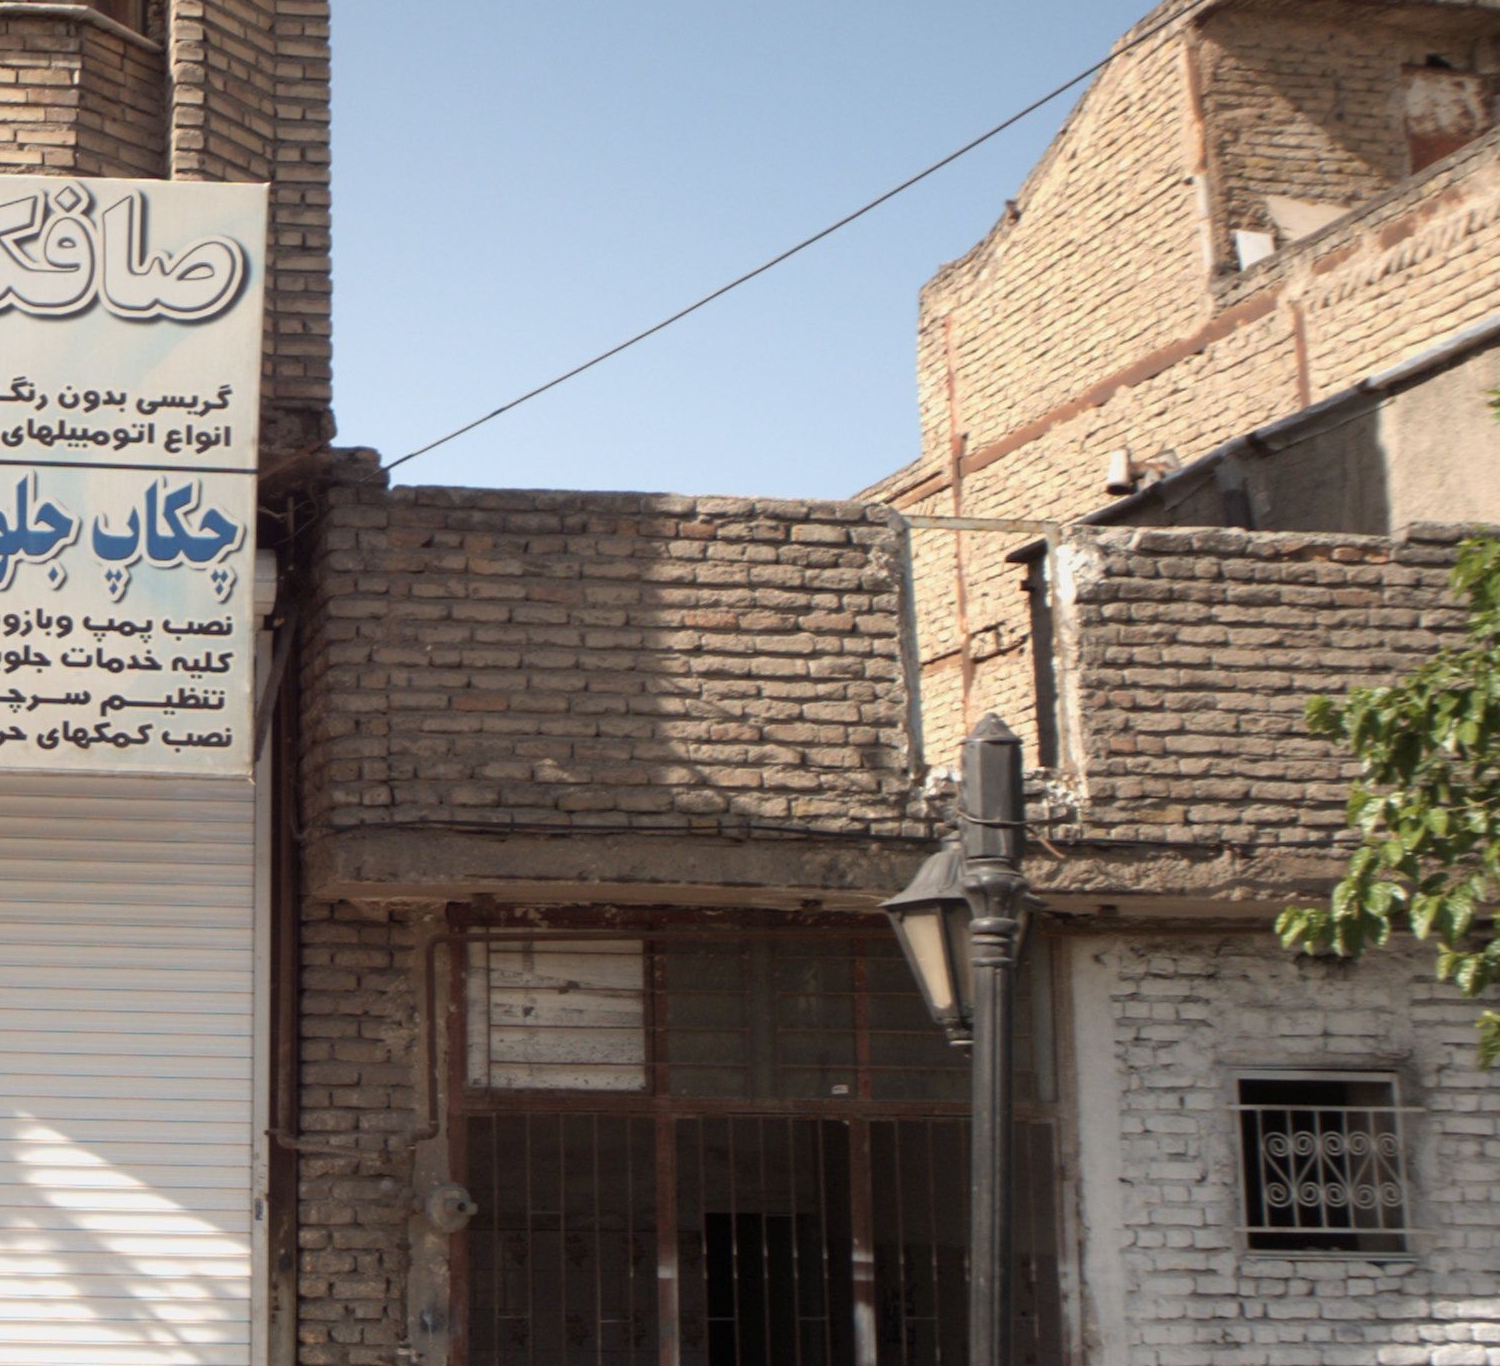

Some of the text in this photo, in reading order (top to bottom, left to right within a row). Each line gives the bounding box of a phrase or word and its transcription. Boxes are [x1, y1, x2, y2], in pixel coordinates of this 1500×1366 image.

[57, 385, 127, 413] بدون
[135, 384, 233, 418] گریسی
[0, 418, 155, 452] اتومبیلهای
[163, 424, 231, 453] انواع
[92, 483, 238, 592] چکاپ
[82, 616, 153, 644] پمپ
[162, 616, 233, 642] نصب
[60, 647, 163, 674] خدمات
[171, 651, 234, 680] کلیه
[99, 687, 226, 718] تنظیم
[35, 720, 154, 751] کمکهای
[161, 727, 233, 754] نصب
